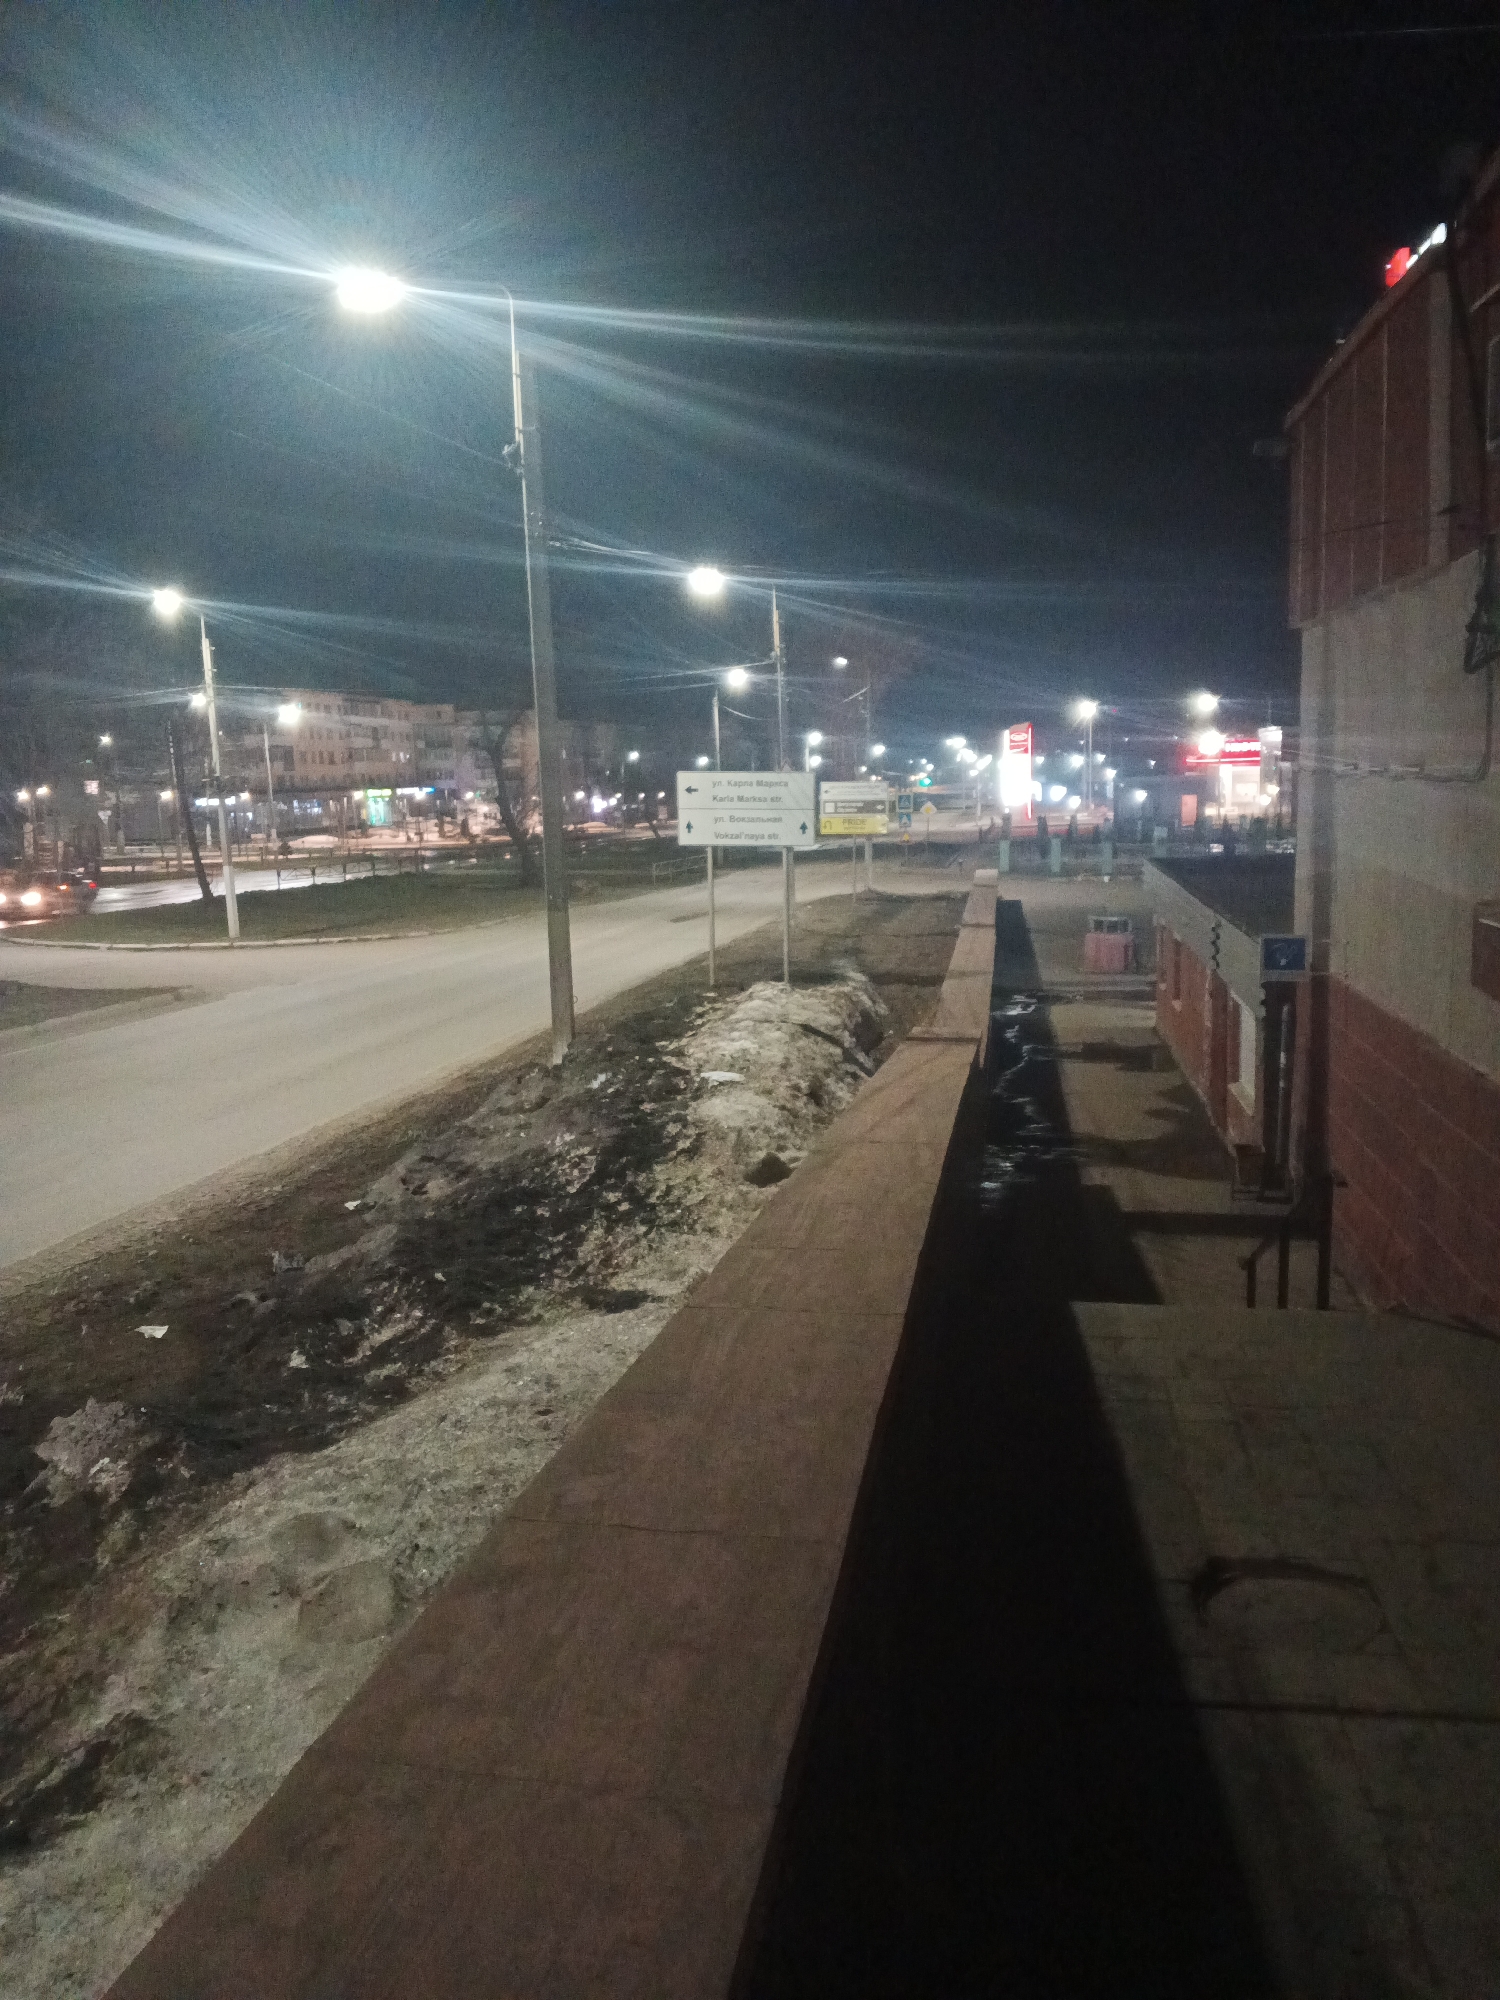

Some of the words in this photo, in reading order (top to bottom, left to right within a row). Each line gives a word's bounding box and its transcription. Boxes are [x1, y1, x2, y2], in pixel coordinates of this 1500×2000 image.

[727, 779, 754, 788] Карла
[756, 779, 789, 788] Маркса
[712, 794, 735, 803] Karla
[736, 794, 768, 803] Marksa
[770, 794, 784, 803] str.
[729, 815, 783, 823] Вокзальная
[767, 832, 782, 840] str.
